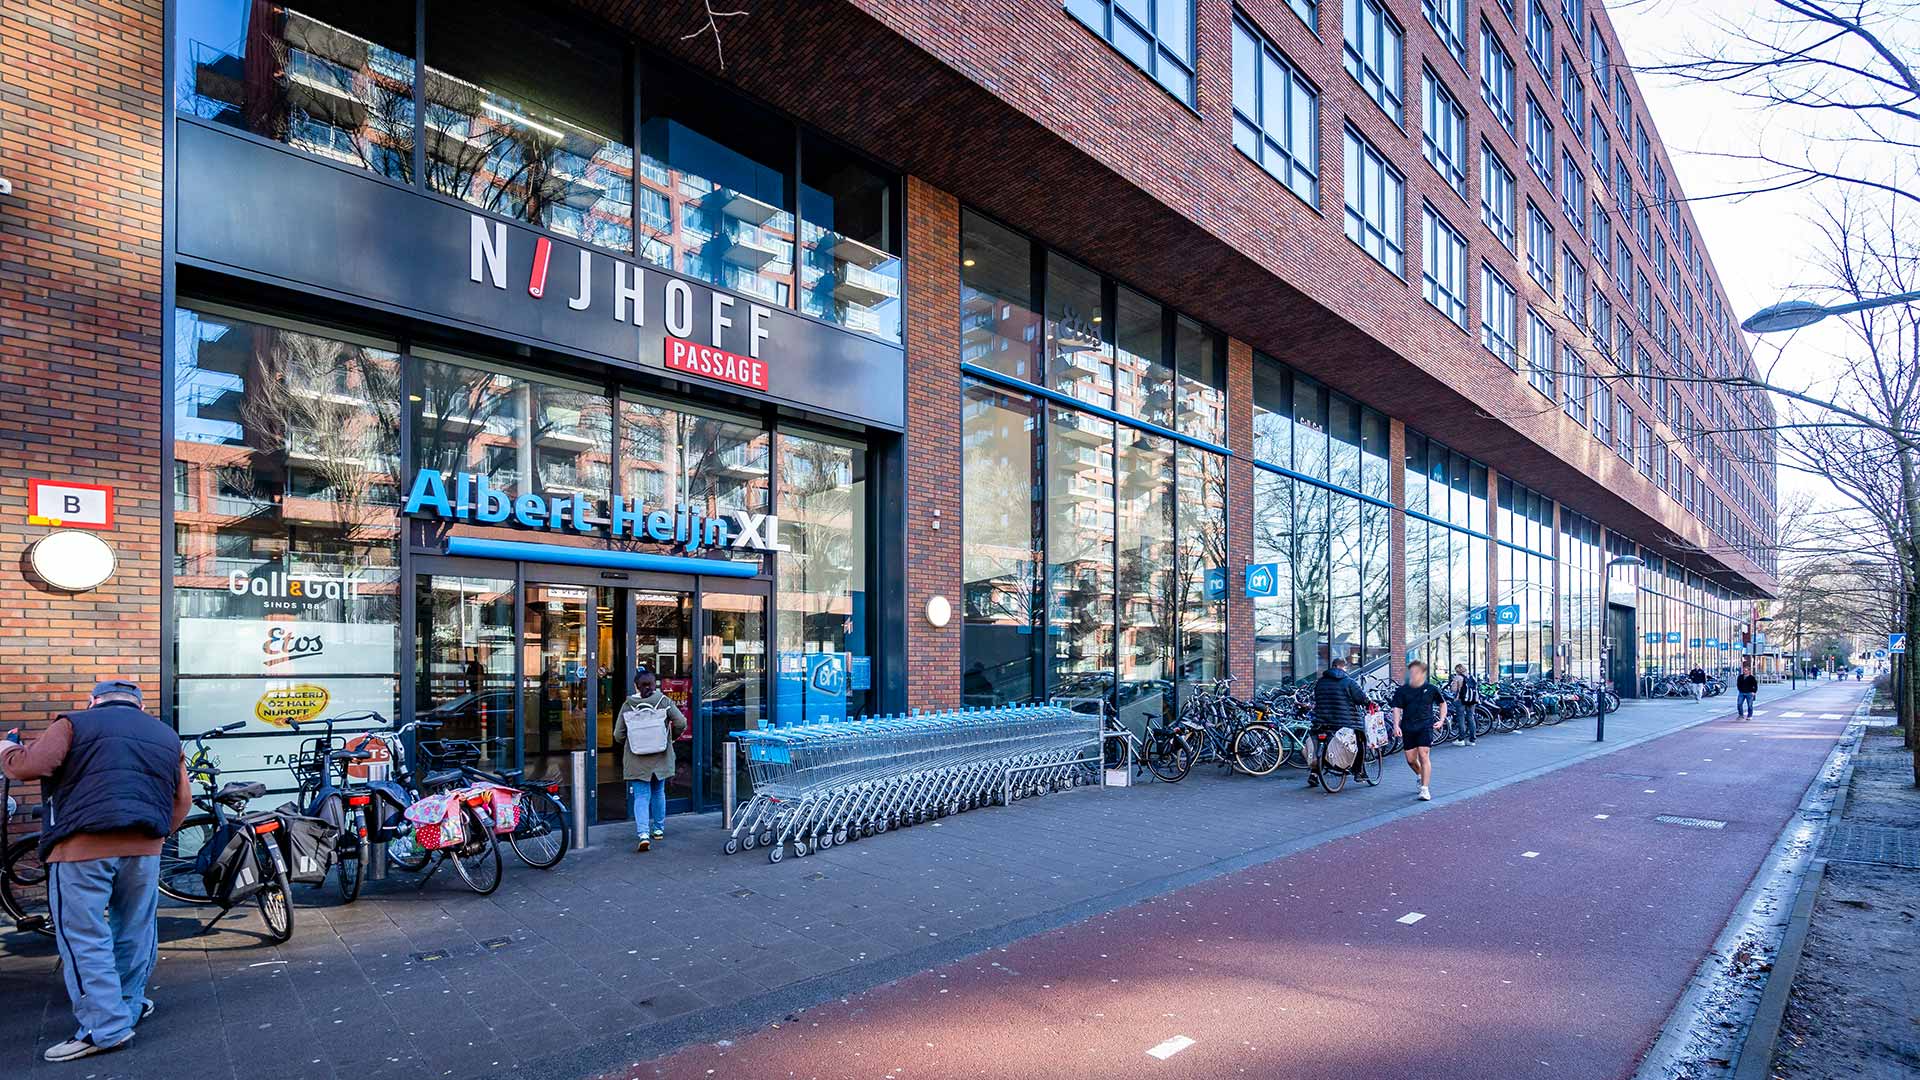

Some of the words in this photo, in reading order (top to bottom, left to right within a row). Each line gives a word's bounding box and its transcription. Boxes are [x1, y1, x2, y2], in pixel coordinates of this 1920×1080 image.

[673, 341, 762, 387] PASSAGE
[63, 494, 81, 514] B
[404, 468, 592, 532] Albert
[611, 494, 728, 552] Heijn
[731, 510, 791, 552] XL
[263, 601, 297, 609] SINDS
[302, 602, 327, 610] 1884
[263, 627, 324, 655] Etos
[263, 708, 310, 717] NIJHOFF
